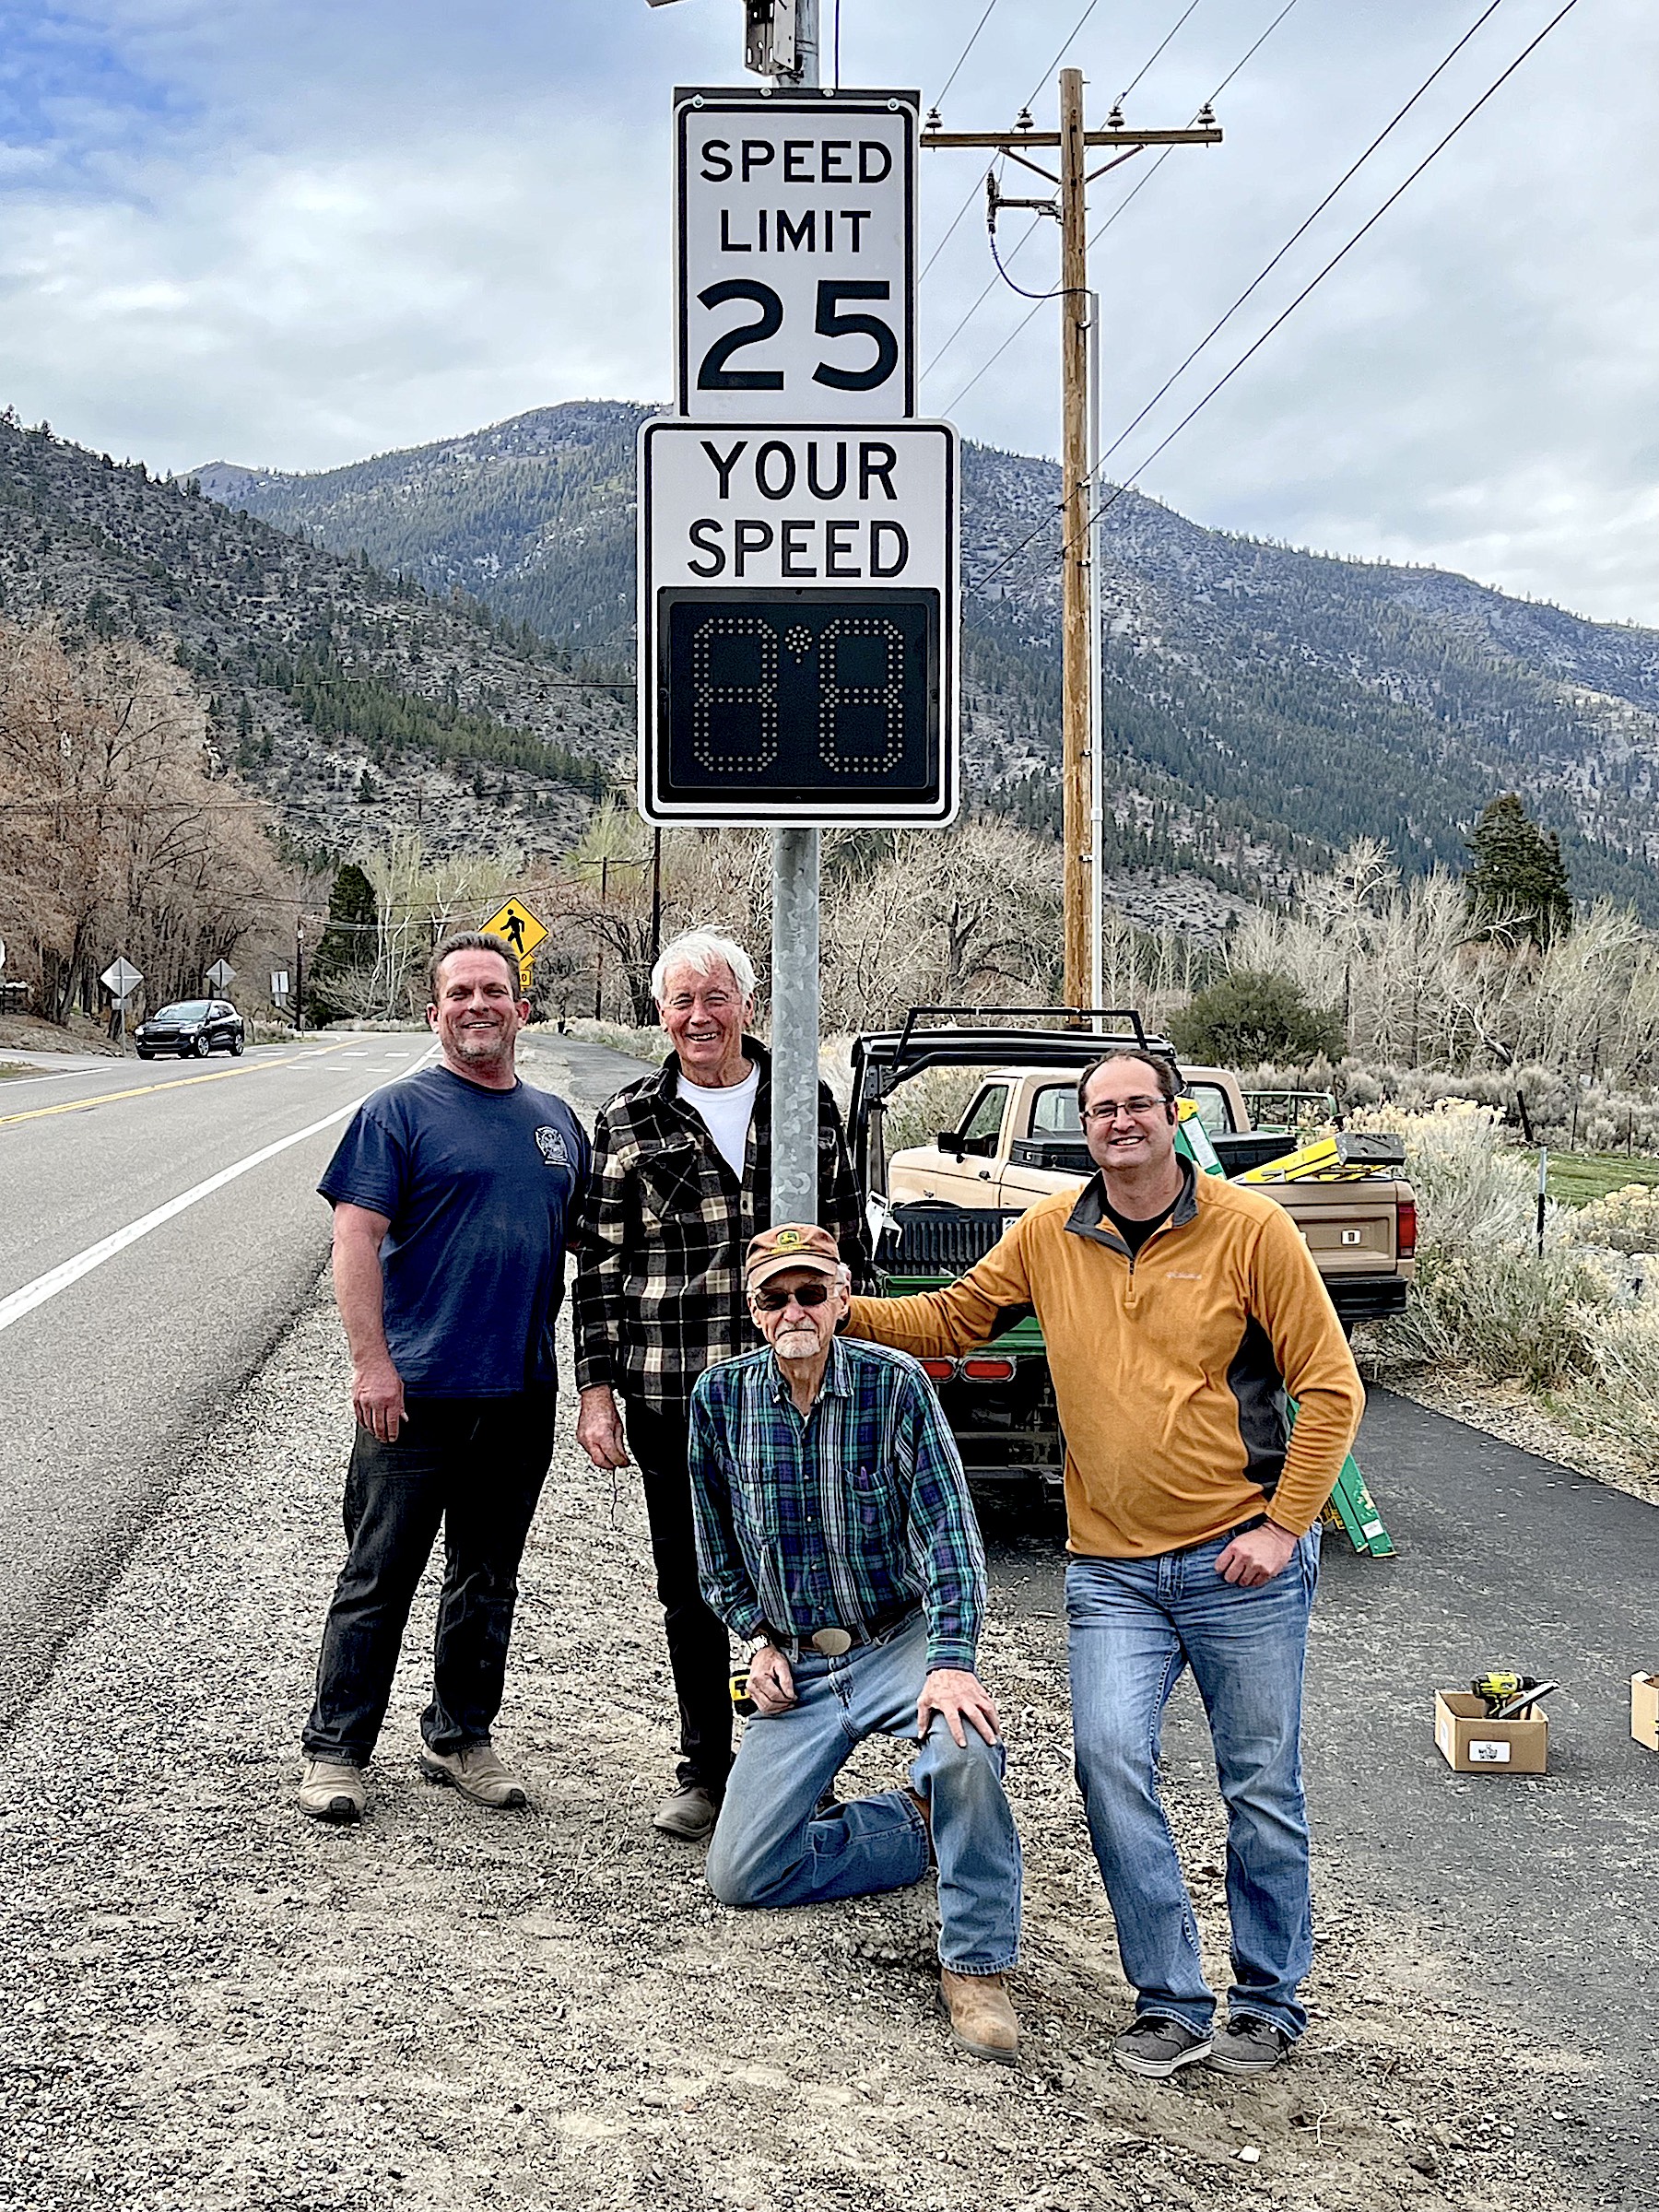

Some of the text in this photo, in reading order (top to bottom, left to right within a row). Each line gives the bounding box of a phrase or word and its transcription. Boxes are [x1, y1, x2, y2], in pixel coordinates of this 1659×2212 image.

[700, 139, 892, 183] SPEED
[721, 209, 872, 253] LIMIT
[696, 278, 899, 392] 25
[700, 440, 898, 500] YOUR
[687, 518, 910, 579] SPEED
